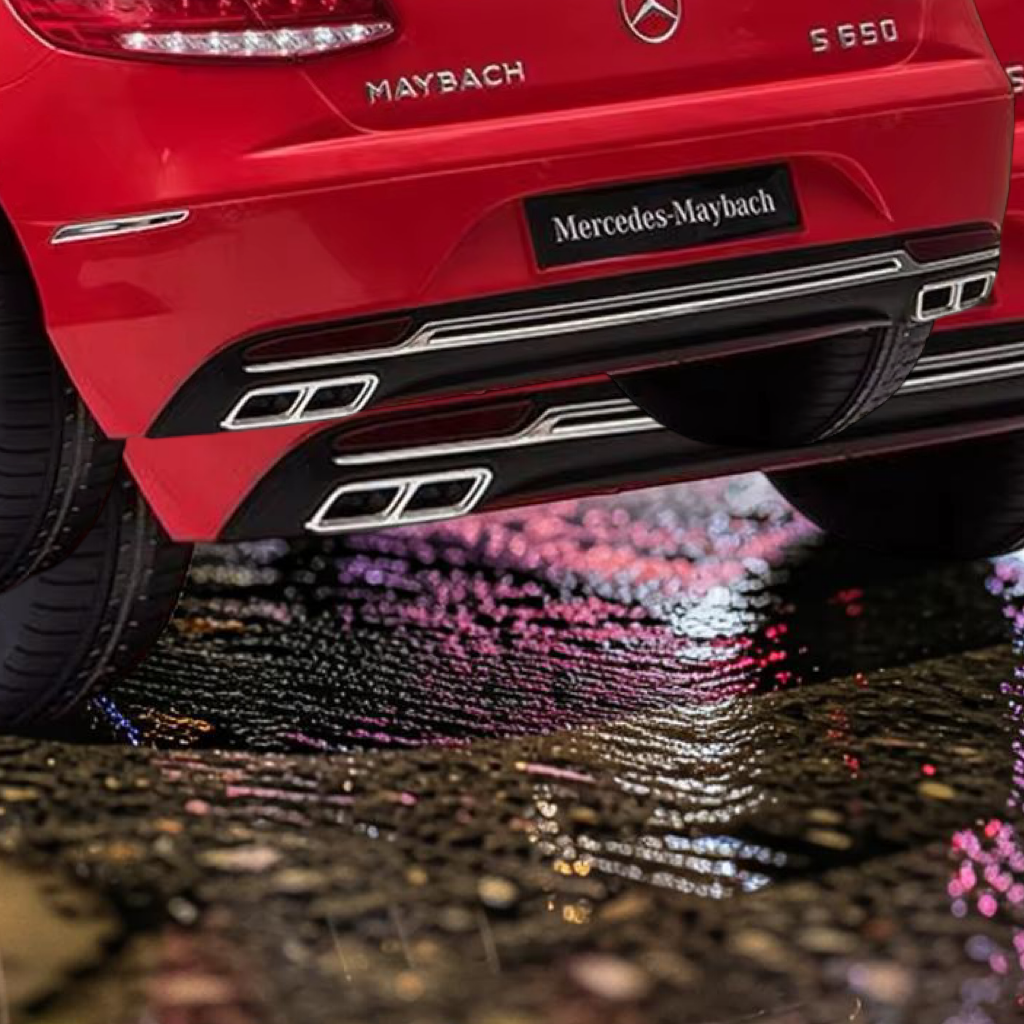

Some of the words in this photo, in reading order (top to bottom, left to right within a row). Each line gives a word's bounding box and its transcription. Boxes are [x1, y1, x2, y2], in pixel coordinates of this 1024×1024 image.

[837, 19, 898, 49] 650
[366, 61, 525, 105] MAYBACH
[552, 189, 776, 243] Mercedes-Maybach
